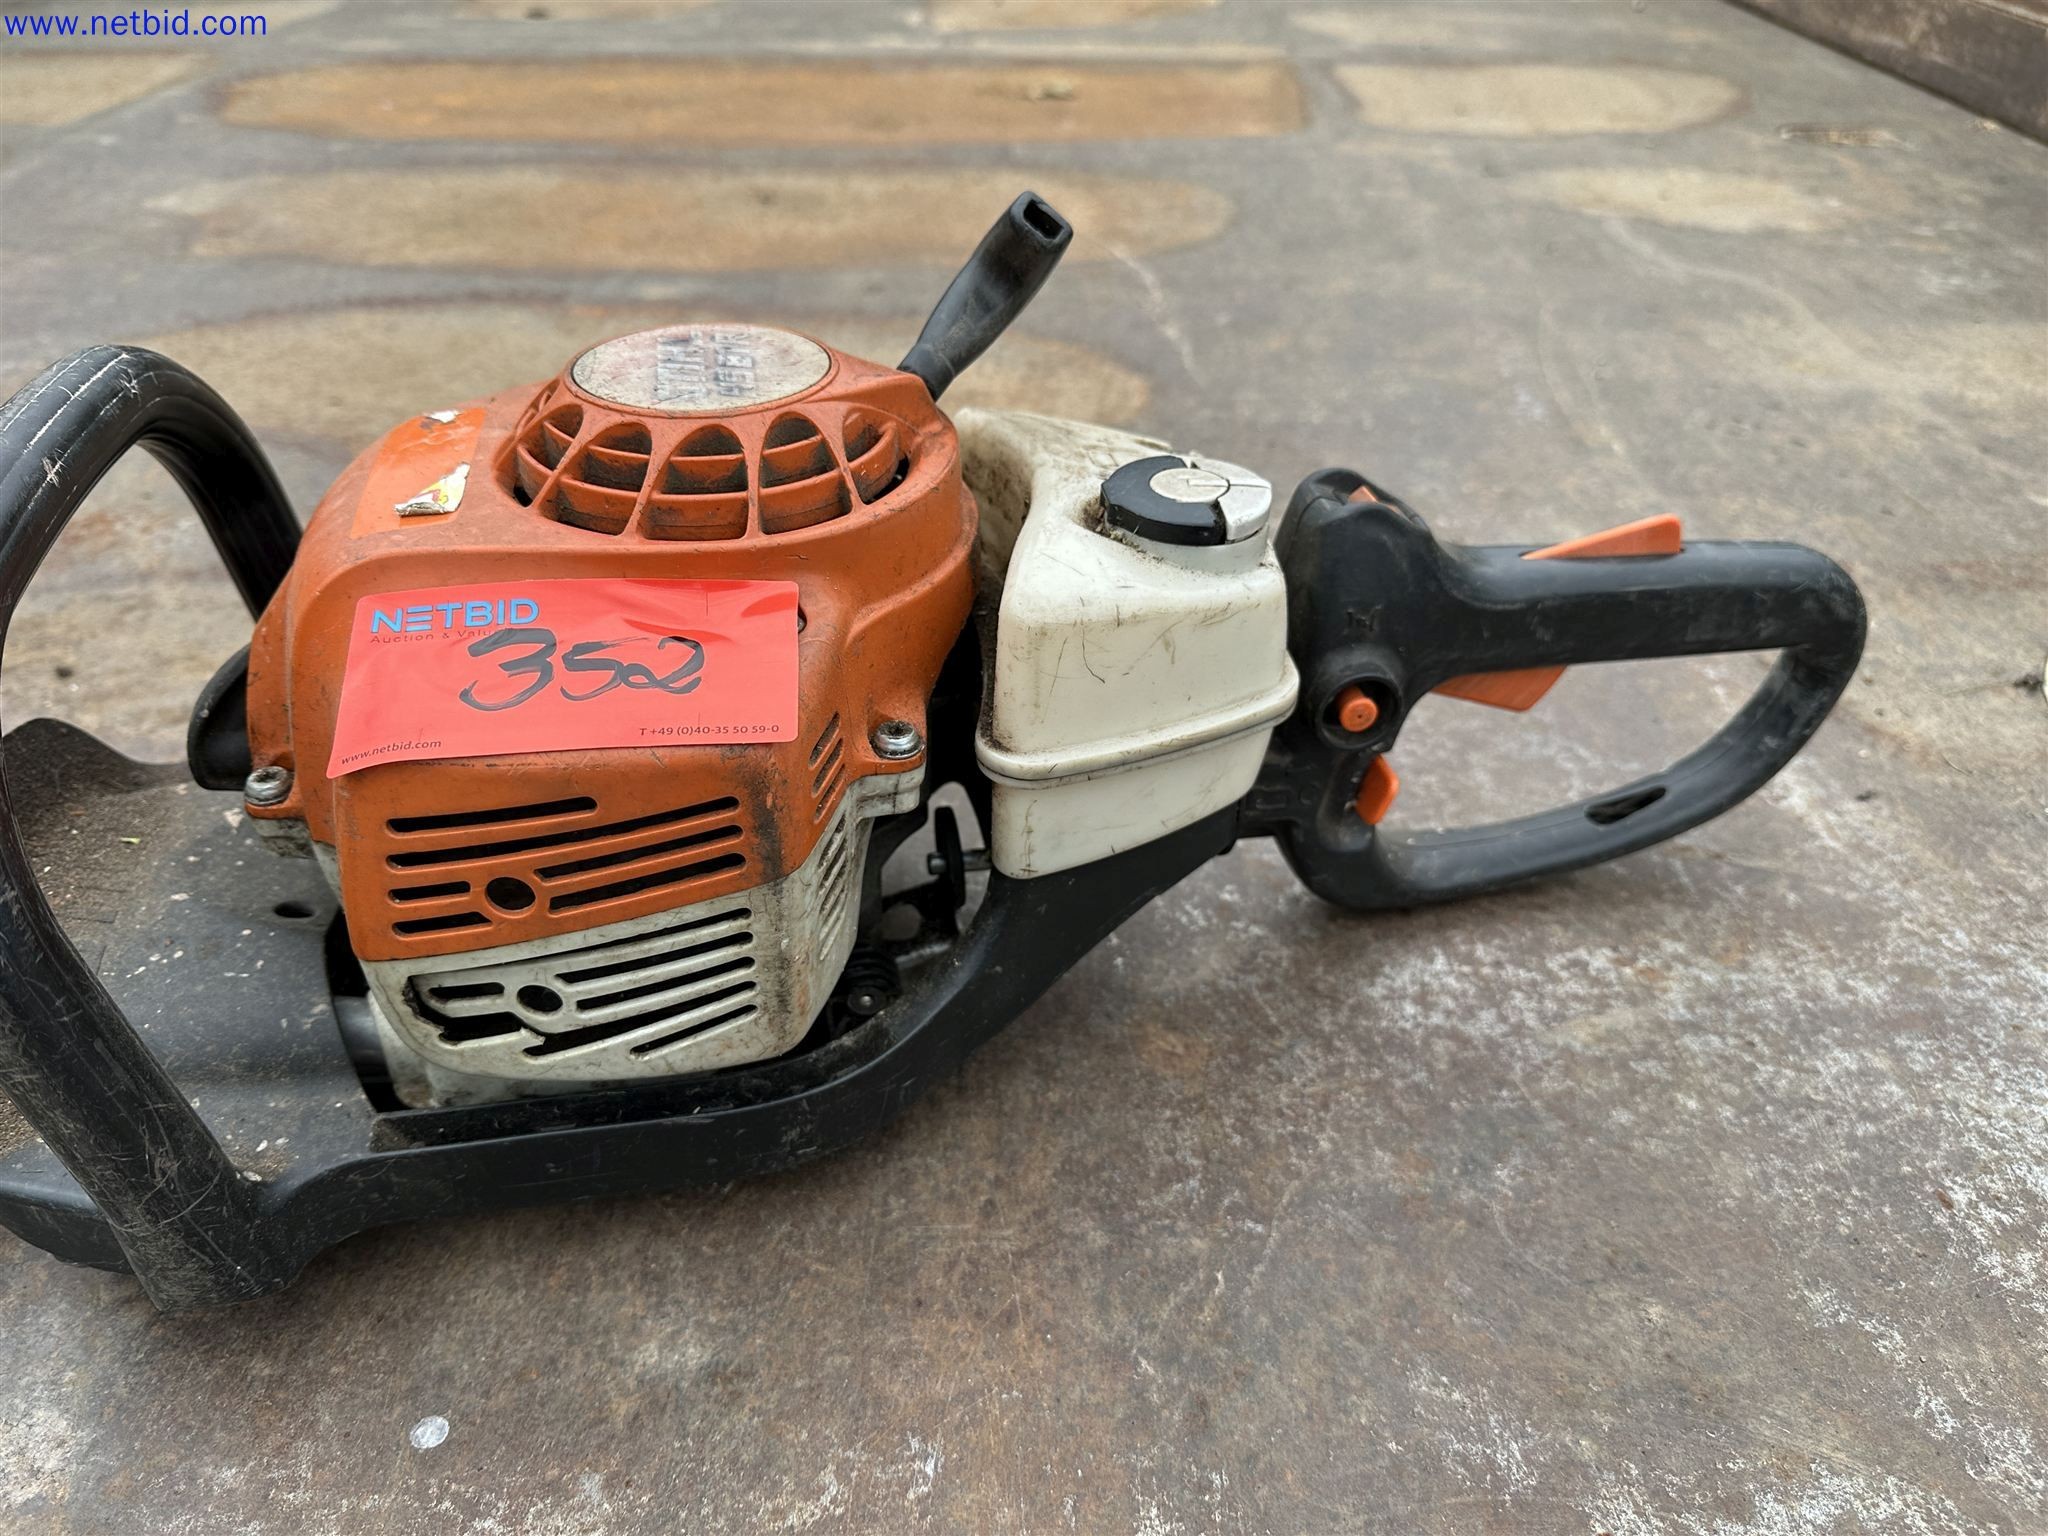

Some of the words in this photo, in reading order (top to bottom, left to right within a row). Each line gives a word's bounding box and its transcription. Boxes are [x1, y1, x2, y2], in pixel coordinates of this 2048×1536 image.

[370, 598, 540, 633] NETBID
[370, 633, 434, 644] Auction
[459, 627, 705, 711] 352
[640, 727, 647, 736] T
[650, 727, 674, 736] +49
[677, 726, 729, 736] (0)40-35
[733, 726, 748, 734] 50
[751, 724, 779, 734] 59-0
[341, 740, 442, 765] www.netbid.com
